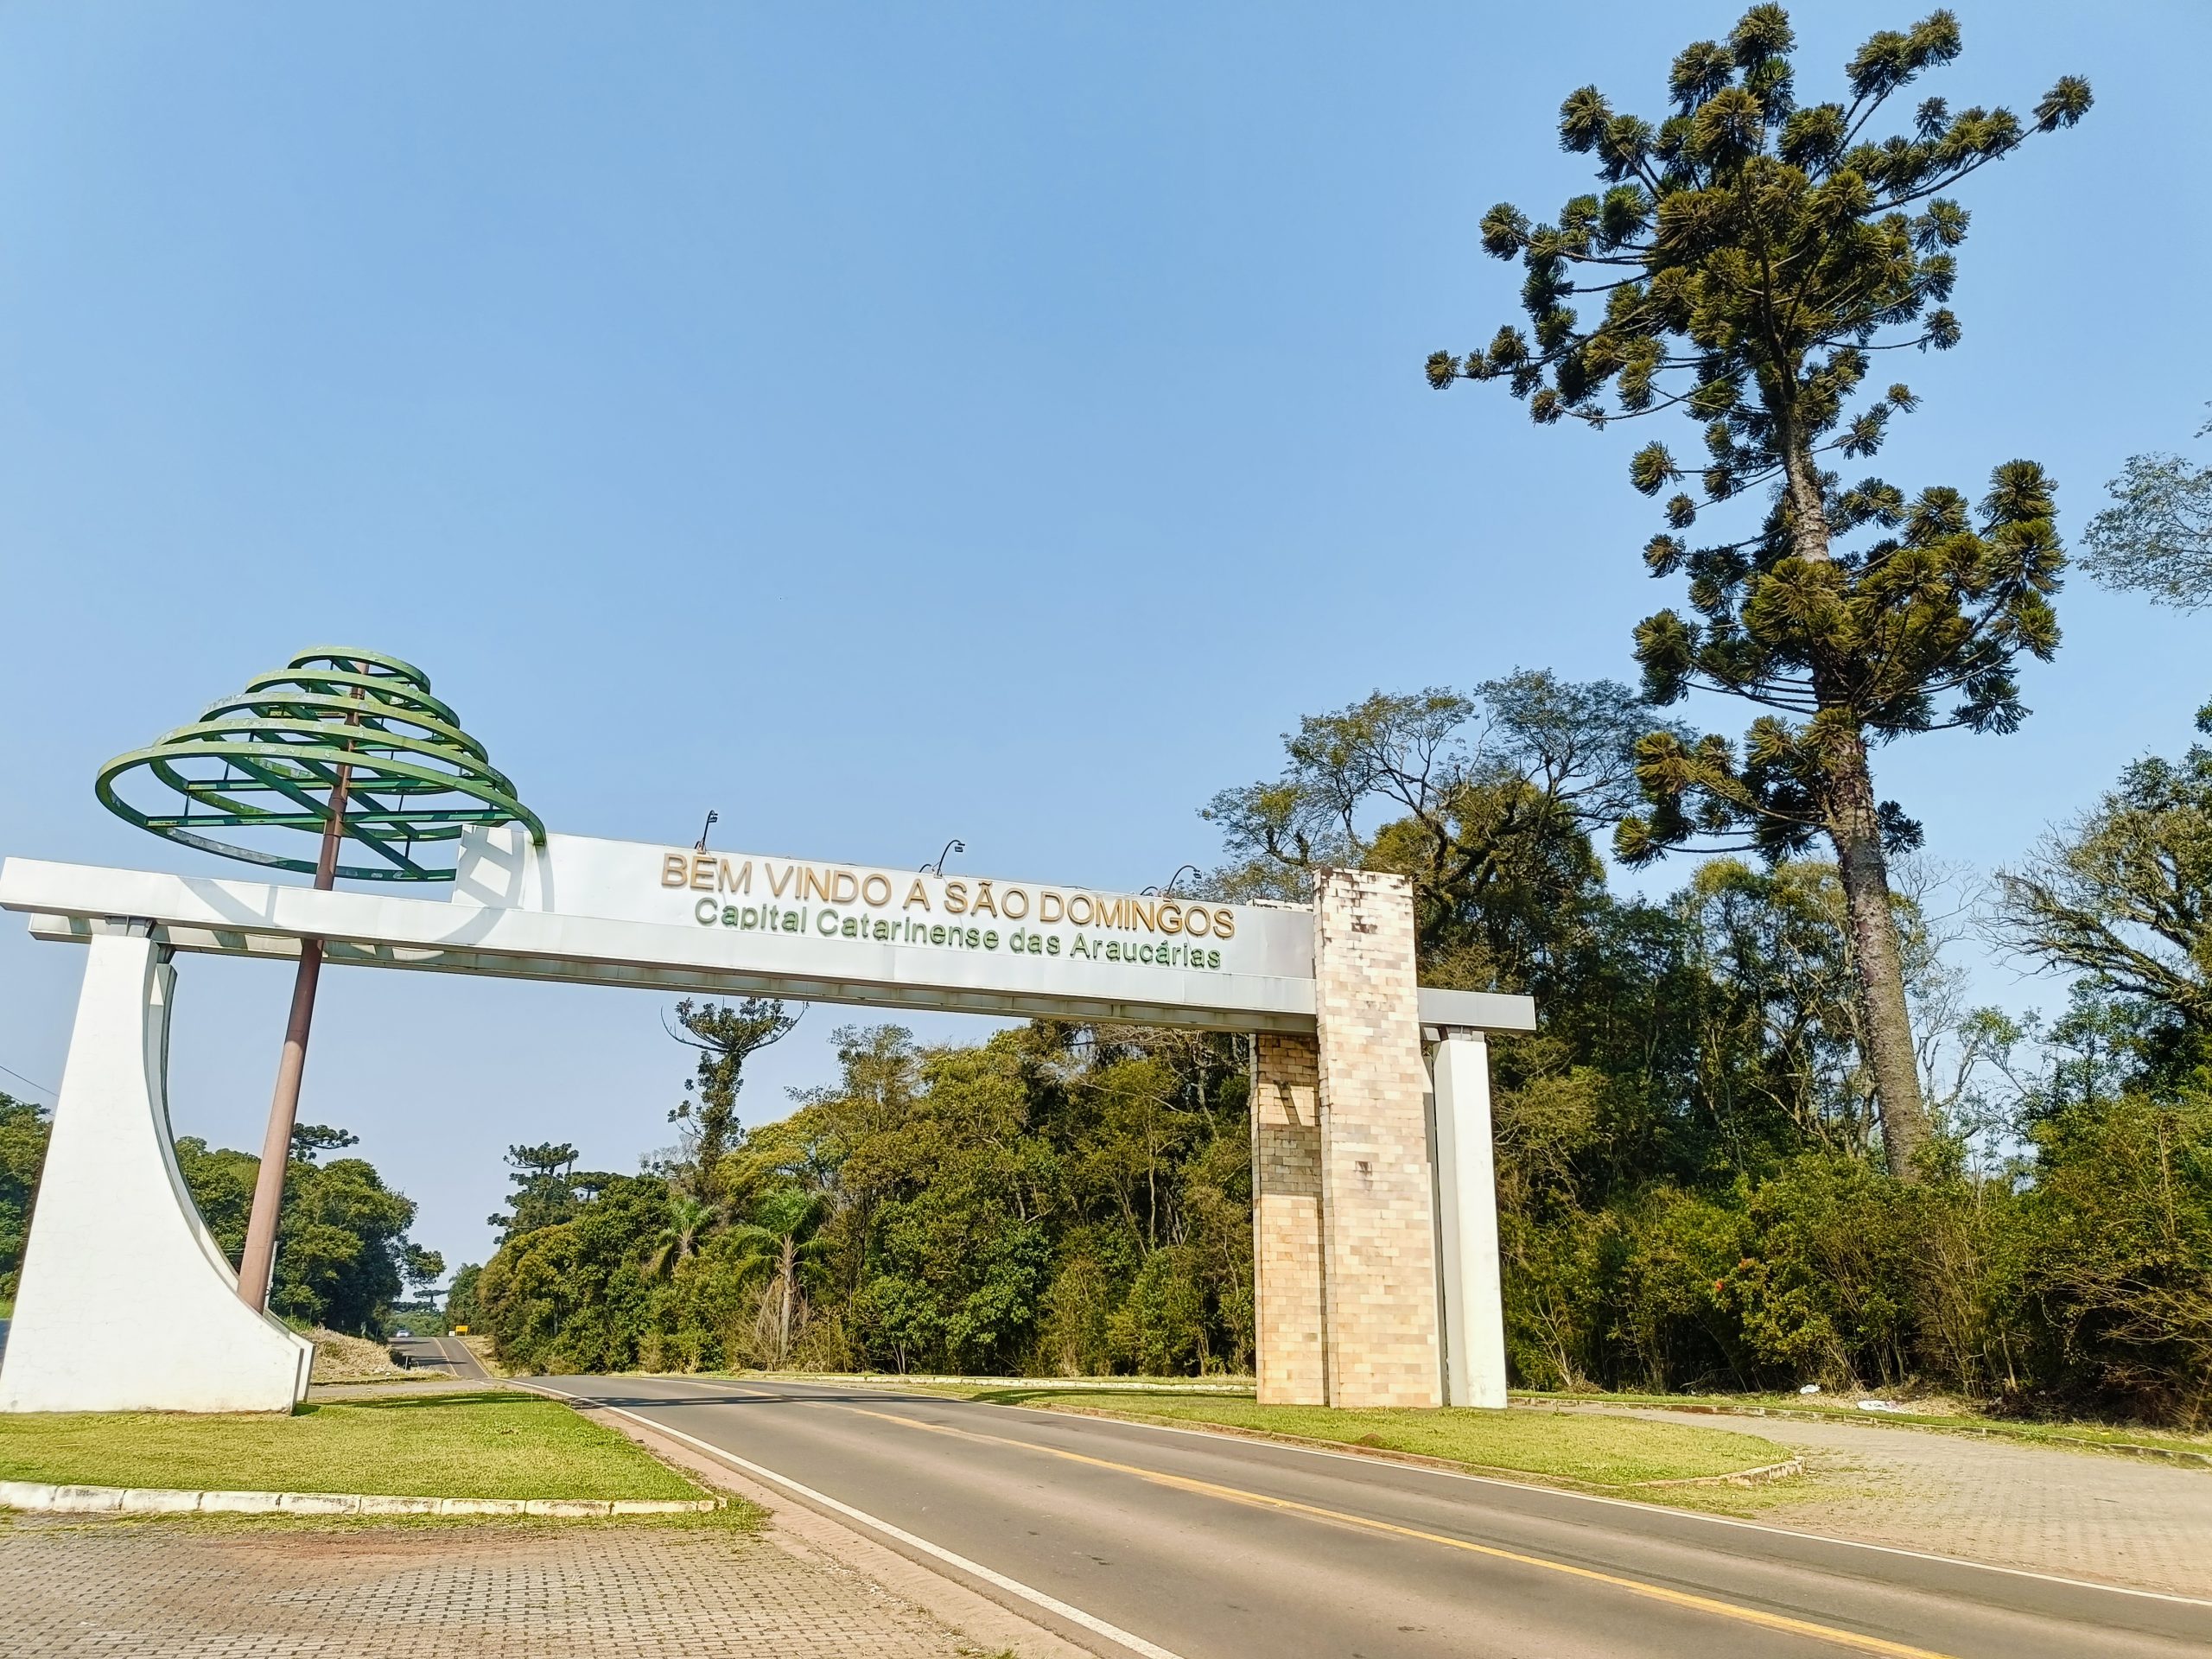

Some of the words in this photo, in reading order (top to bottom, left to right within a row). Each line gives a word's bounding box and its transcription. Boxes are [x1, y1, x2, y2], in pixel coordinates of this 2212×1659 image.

[661, 853, 752, 893] BEM
[765, 863, 892, 906] VINDO
[903, 878, 931, 911] A
[944, 880, 1029, 919] SÃO
[1039, 891, 1236, 938] DOMINGOS
[695, 897, 807, 932] Capital
[816, 908, 999, 950] Catarinense
[1009, 927, 1059, 956] das
[1070, 932, 1221, 969] Araucárias
